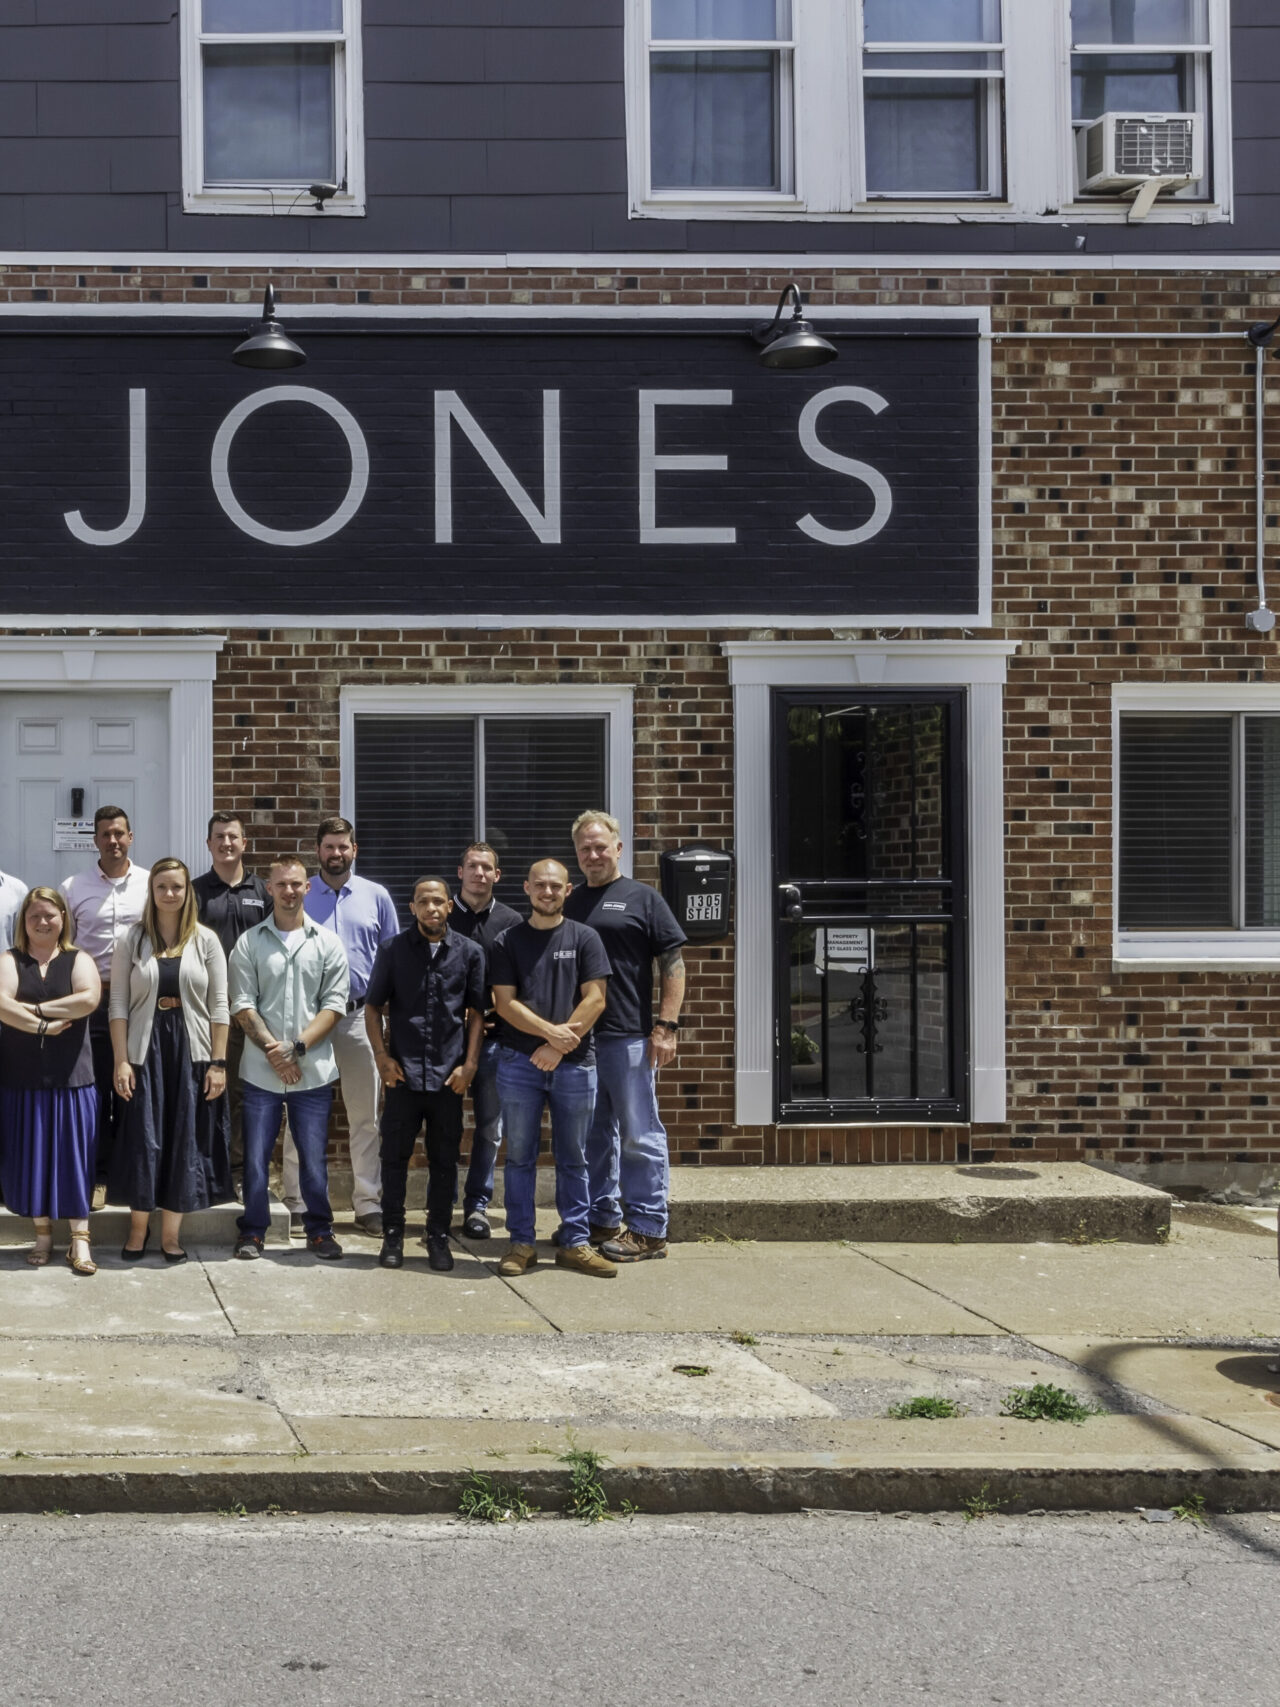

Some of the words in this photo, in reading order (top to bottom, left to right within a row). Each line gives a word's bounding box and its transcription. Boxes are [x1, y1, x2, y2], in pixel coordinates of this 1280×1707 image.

[63, 383, 893, 547] JONES
[690, 894, 721, 907] 1305
[688, 907, 710, 920] STE
